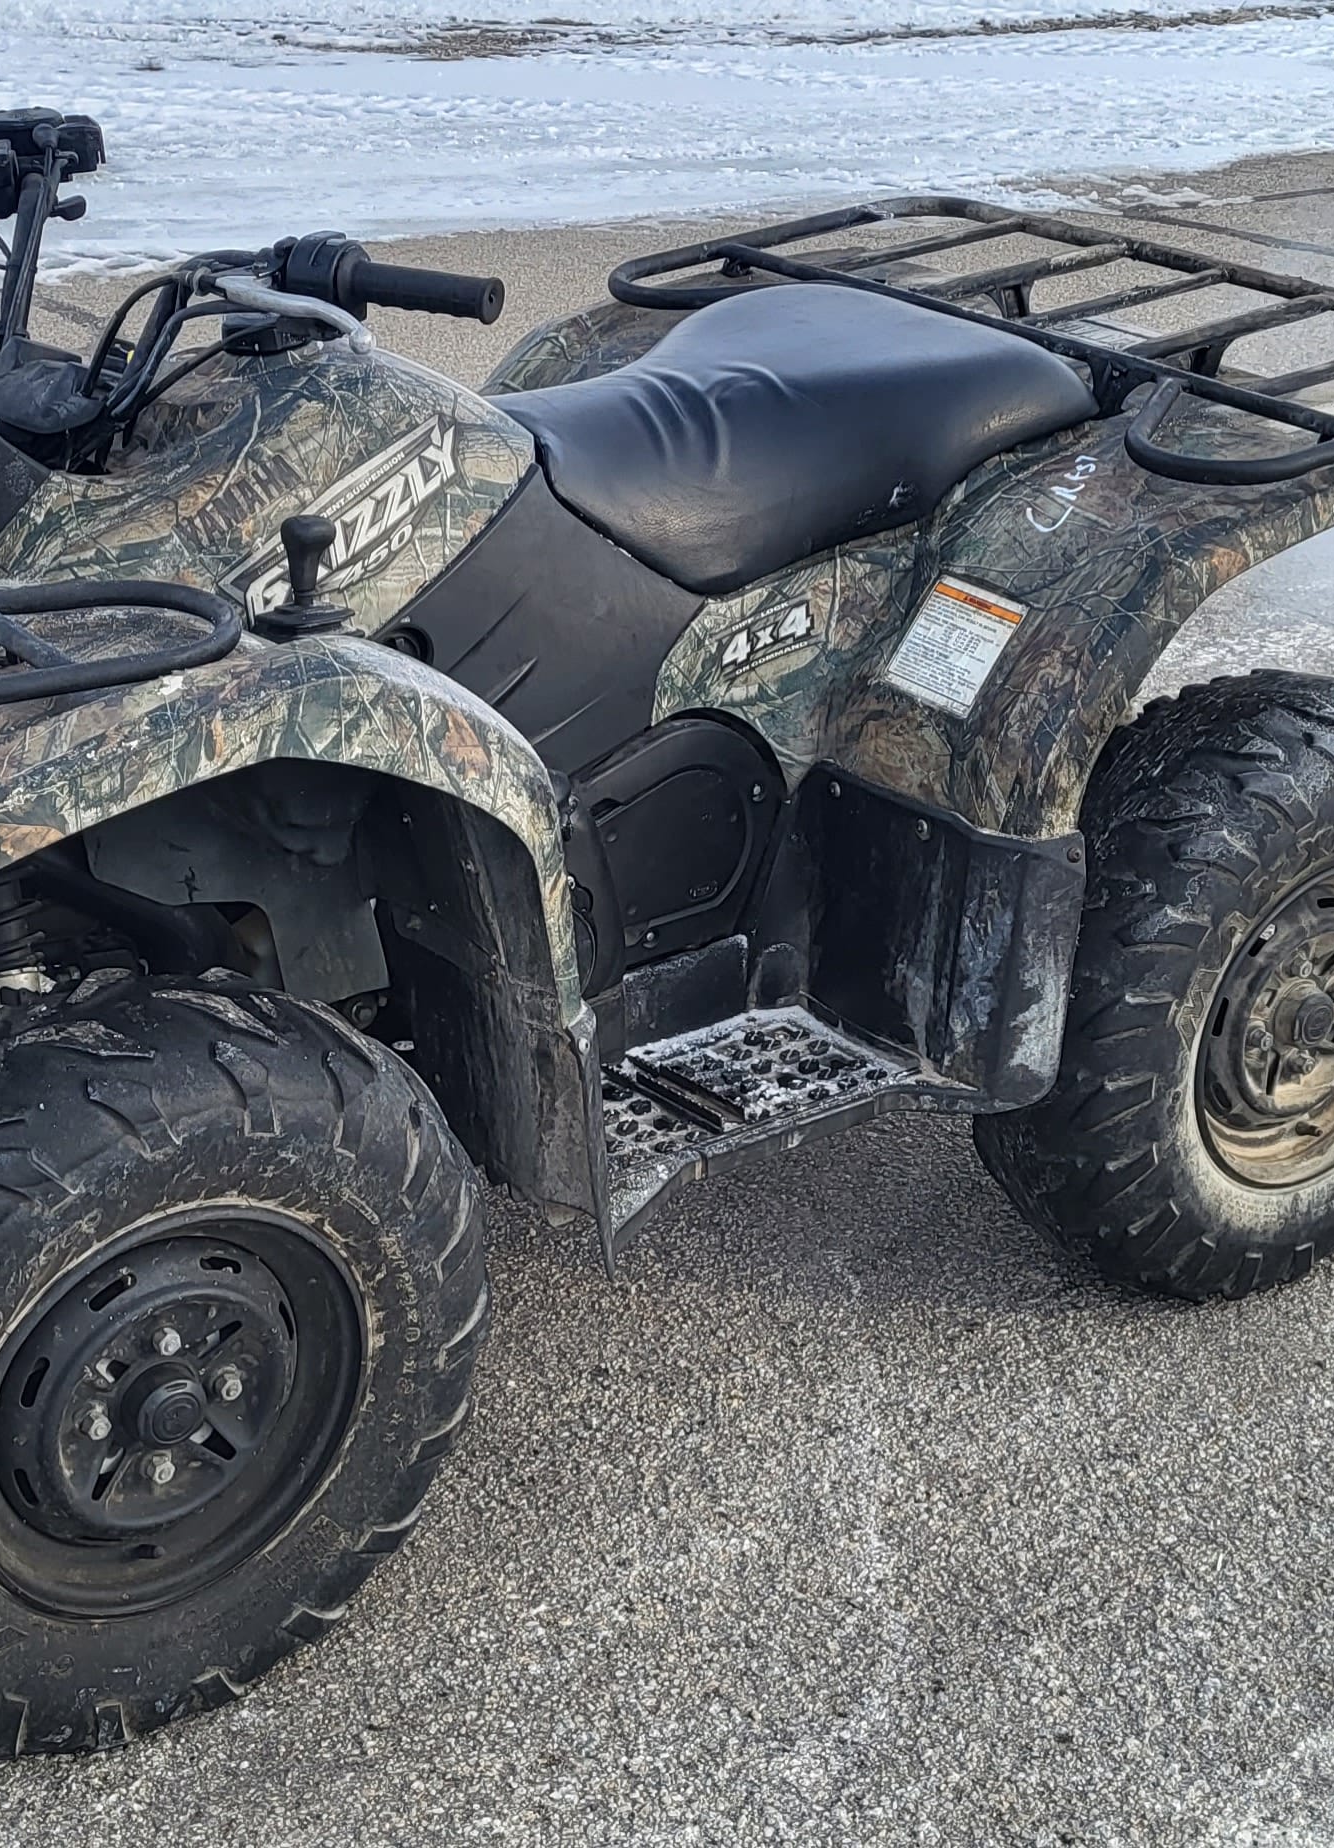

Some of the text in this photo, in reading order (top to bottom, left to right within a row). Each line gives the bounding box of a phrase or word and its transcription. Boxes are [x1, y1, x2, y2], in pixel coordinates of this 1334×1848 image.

[174, 454, 304, 549] YAMAHA
[347, 452, 405, 502] SUSPENSION
[245, 424, 457, 630] GIZZLY
[339, 523, 413, 590] 450
[751, 641, 808, 668] COMMAND
